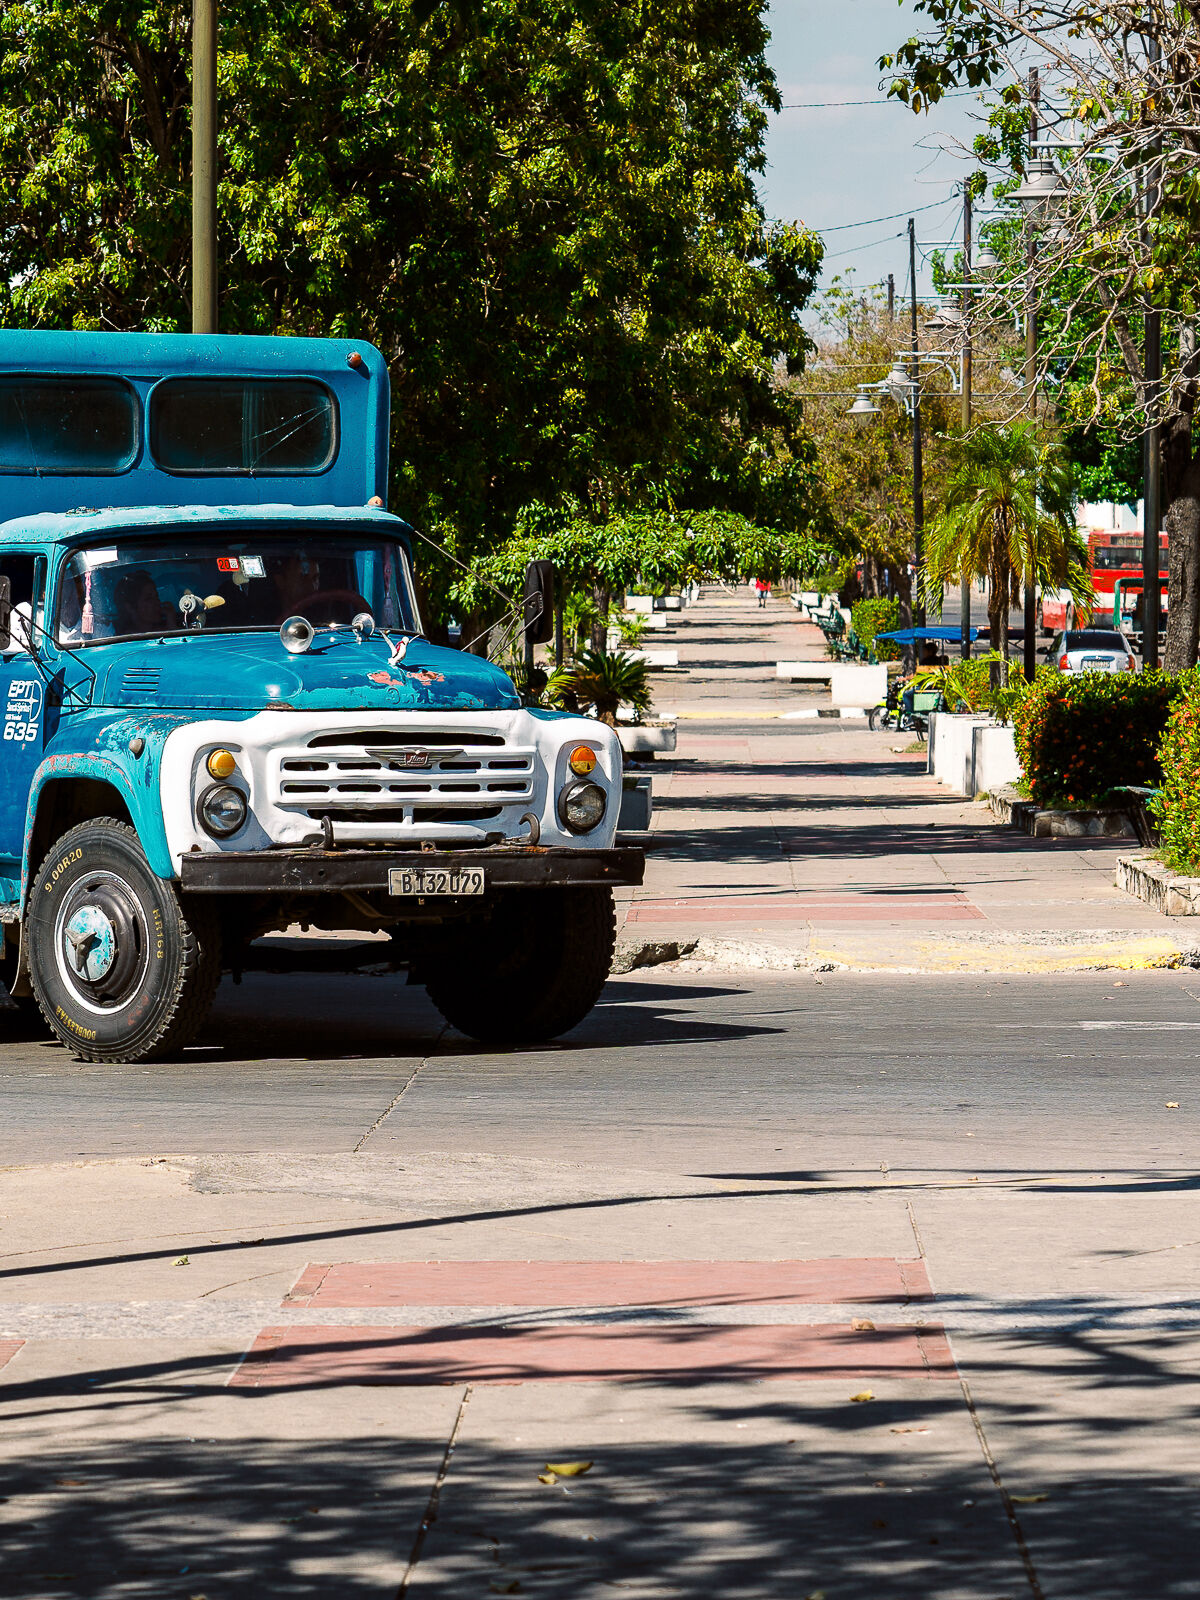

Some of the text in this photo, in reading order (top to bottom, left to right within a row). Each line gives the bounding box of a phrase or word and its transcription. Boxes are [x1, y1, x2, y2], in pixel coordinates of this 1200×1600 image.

[218, 559, 231, 570] 20
[8, 680, 34, 698] EPT
[3, 721, 39, 742] 635
[44, 848, 83, 893] 9.00R20
[401, 873, 482, 894] B132079
[55, 1005, 97, 1041] DOUBLESTAR
